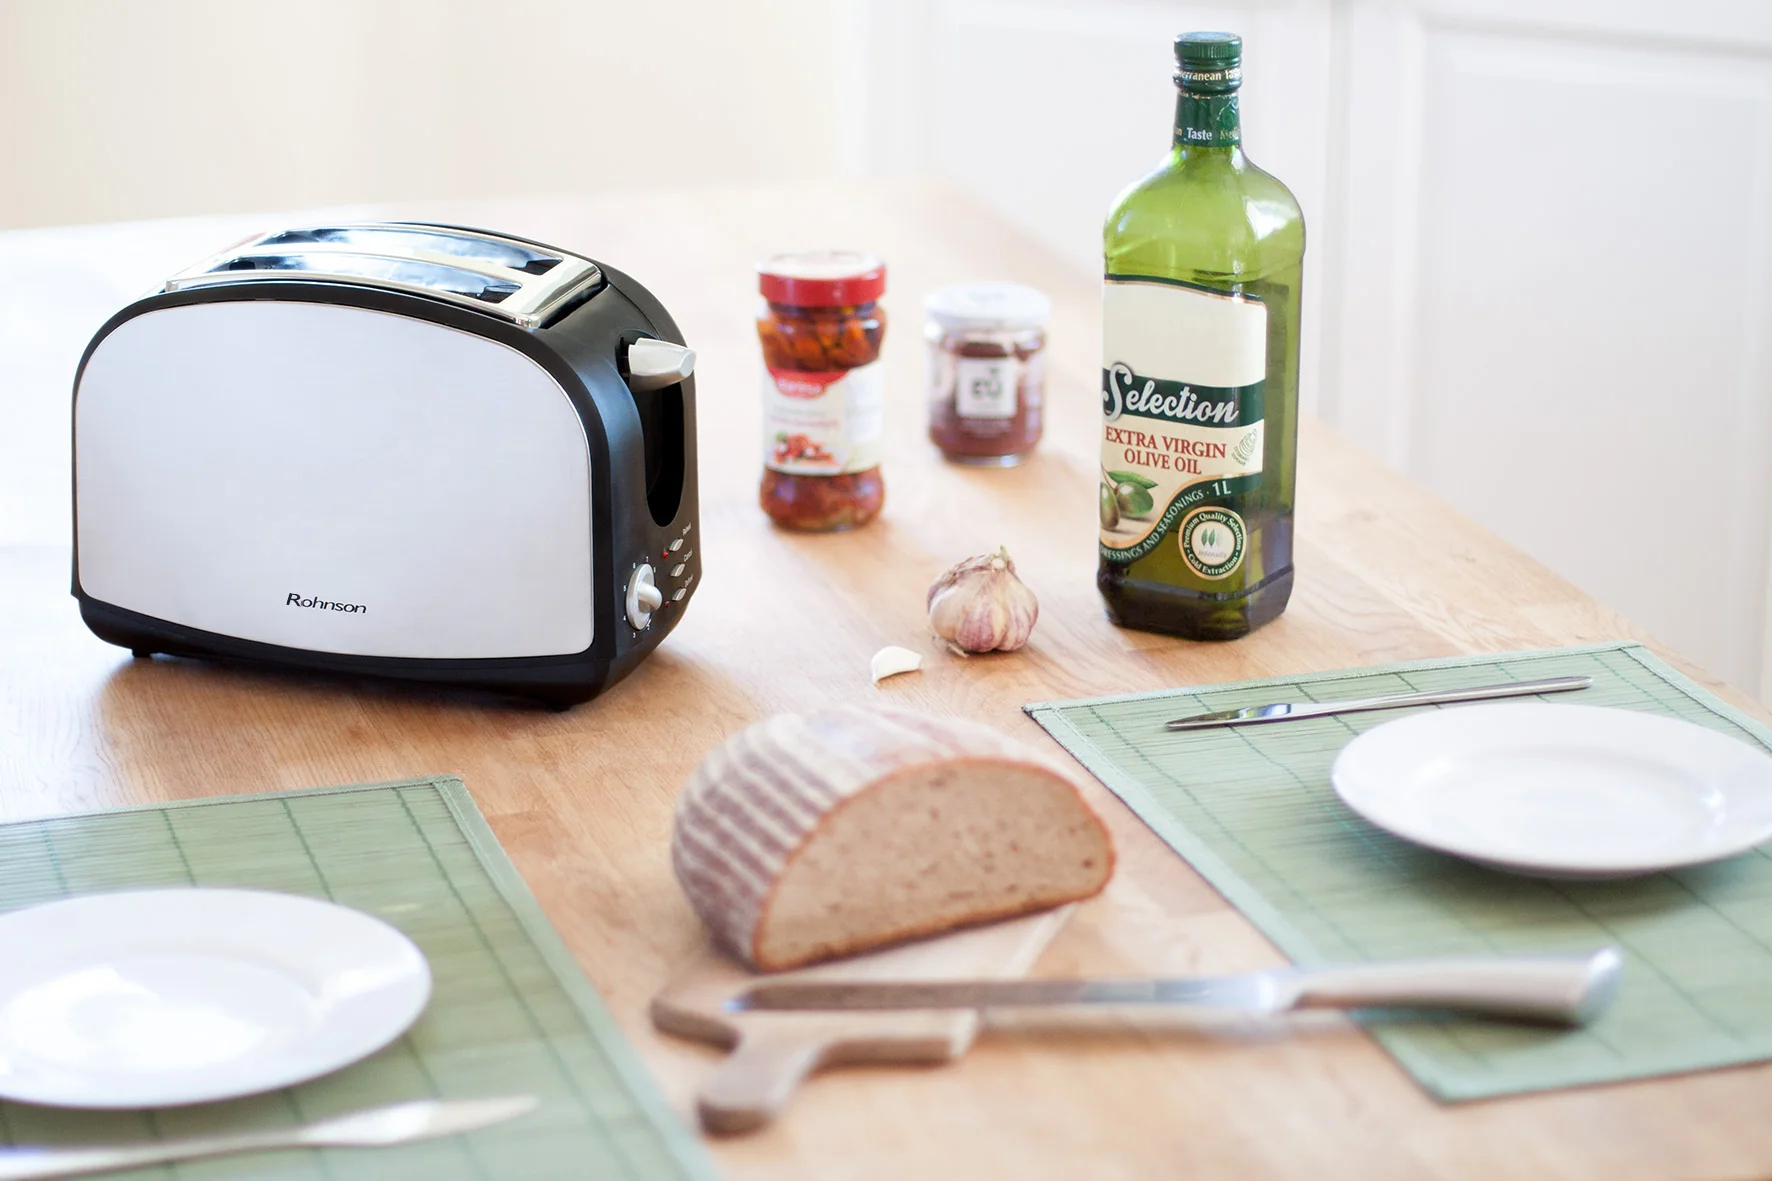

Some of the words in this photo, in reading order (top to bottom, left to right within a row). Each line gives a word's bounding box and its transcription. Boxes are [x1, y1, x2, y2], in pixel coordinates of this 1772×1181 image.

[1186, 127, 1212, 140] Taste
[1101, 362, 1239, 423] Selection
[1105, 425, 1159, 451] EXTRA
[1161, 435, 1227, 459] VIRGIN
[1124, 448, 1170, 470] OLIVE
[1174, 455, 1201, 475] OIL
[1142, 532, 1160, 552] AND
[1156, 489, 1204, 533] SEASONINGS
[1212, 480, 1232, 496] 1L
[1183, 517, 1200, 549] Premium
[1199, 512, 1228, 523] Quality
[1227, 517, 1243, 551] Selection
[1188, 553, 1202, 570] Cold
[1202, 556, 1239, 575] Extraction
[286, 592, 367, 614] Rohnson
